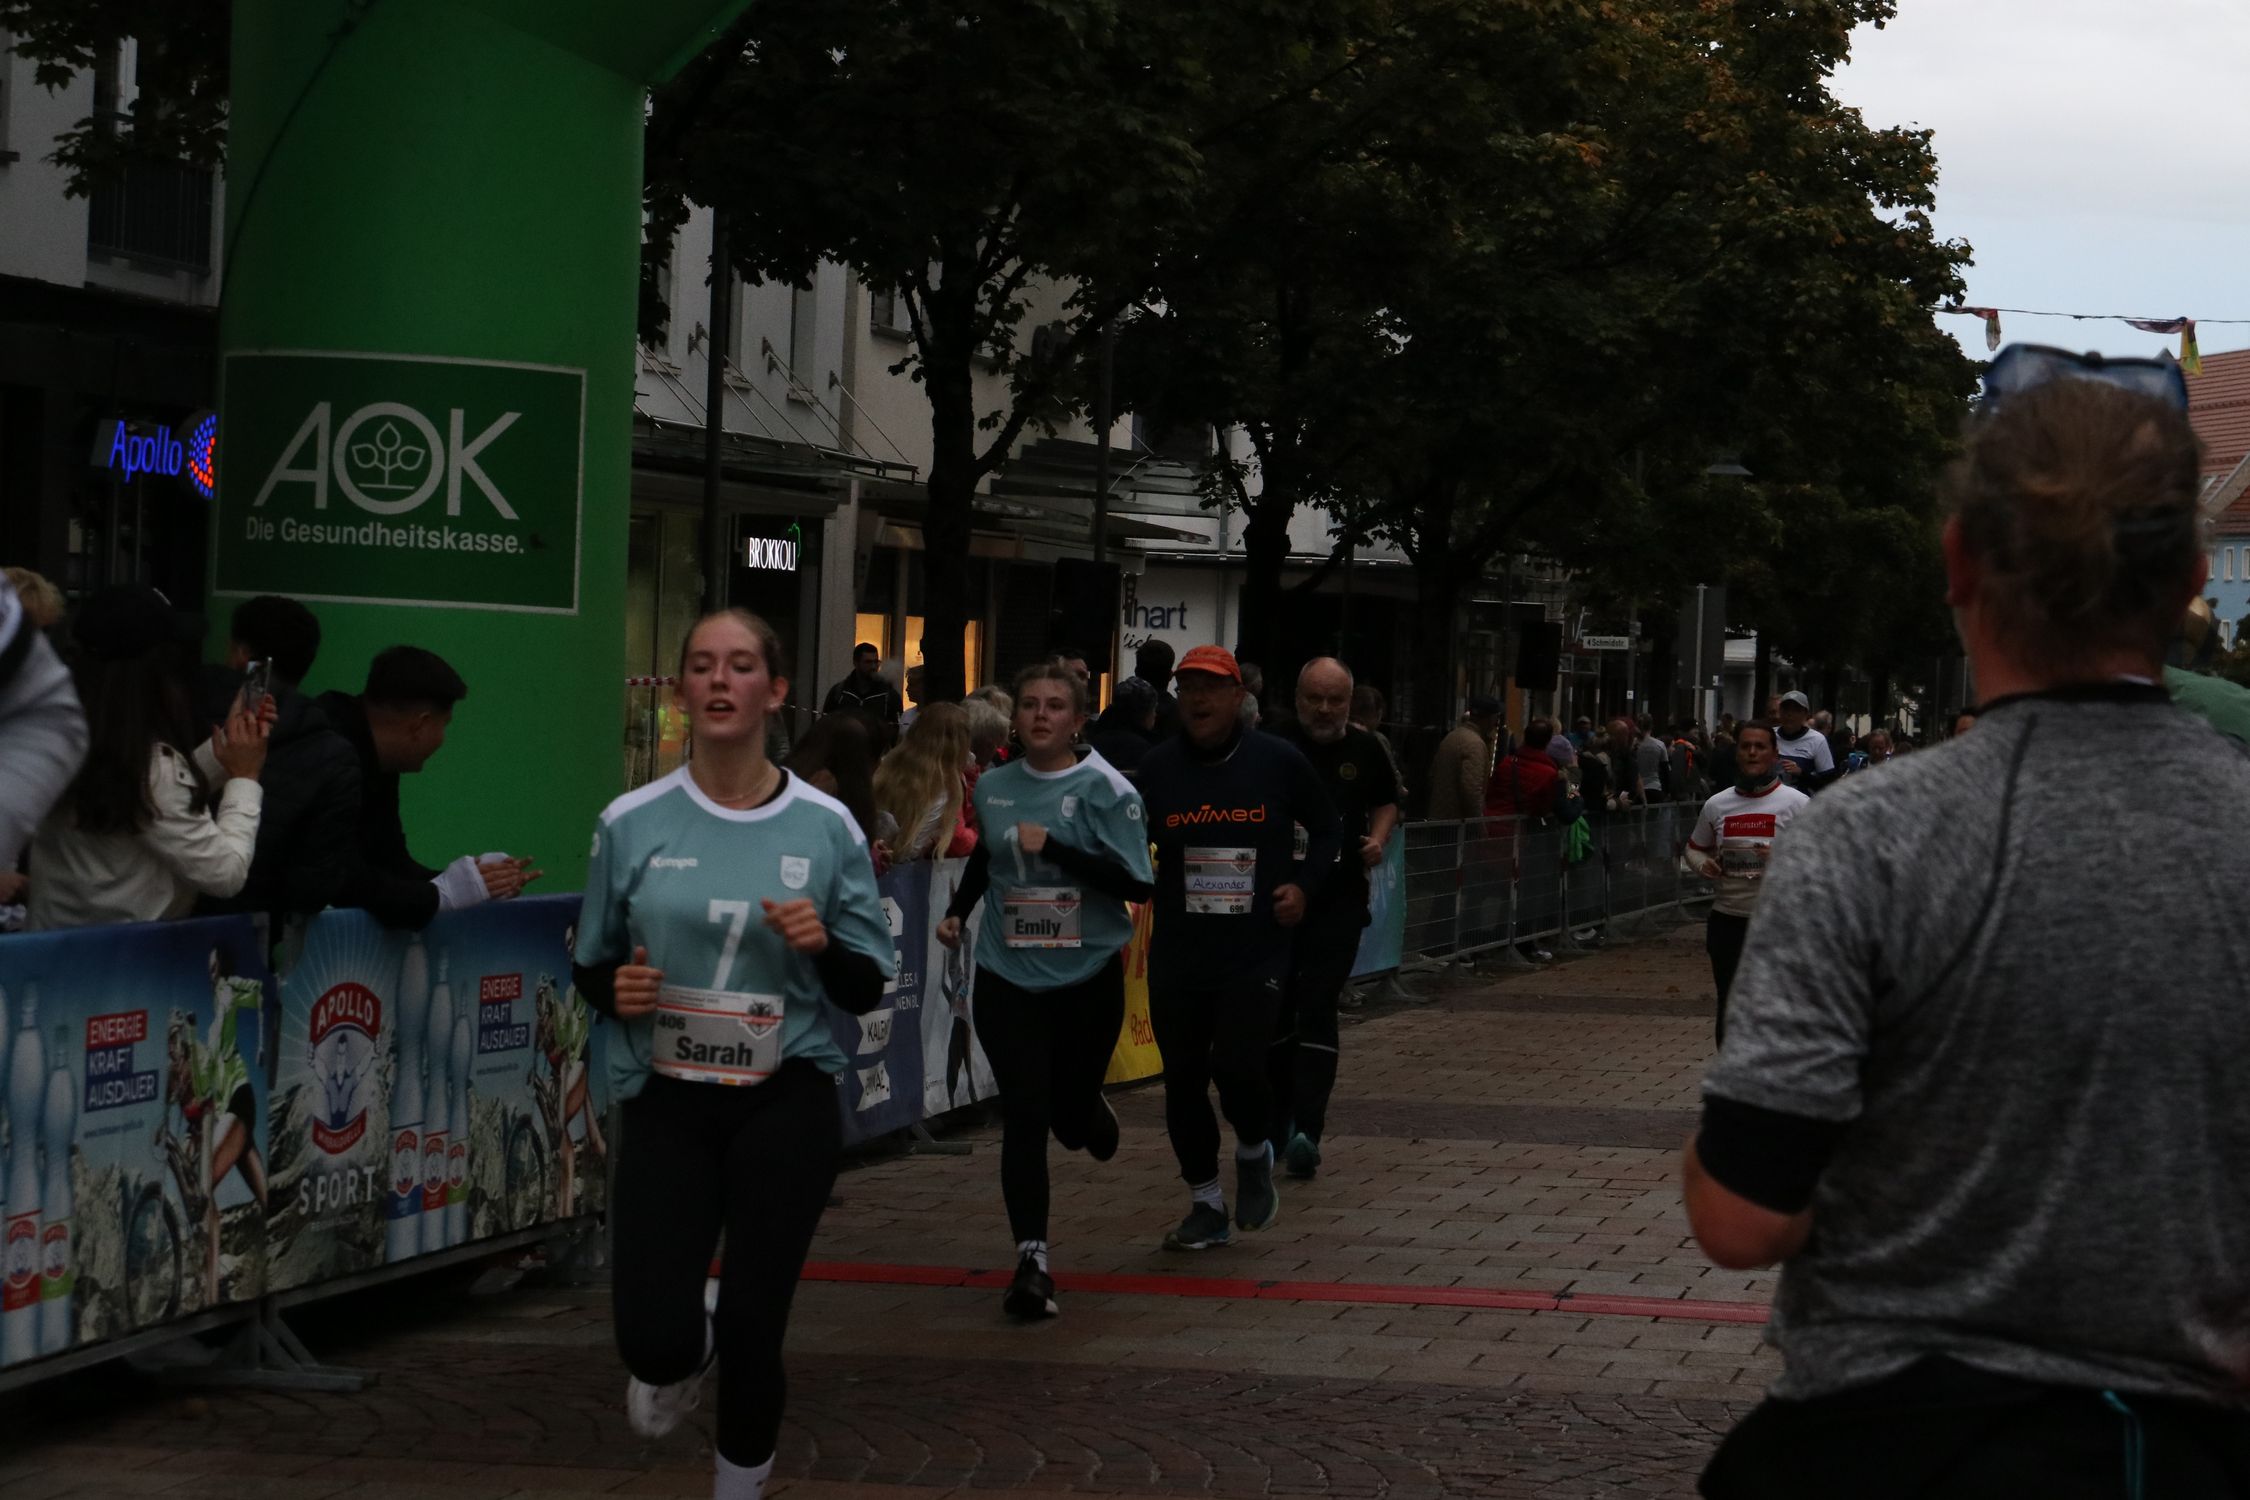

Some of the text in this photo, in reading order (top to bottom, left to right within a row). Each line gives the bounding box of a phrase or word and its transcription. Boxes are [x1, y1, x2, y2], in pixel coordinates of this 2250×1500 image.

[108, 419, 183, 484] Apollo
[253, 401, 523, 520] AOK
[246, 516, 525, 554] Die Gesundheitskasse.
[749, 537, 796, 571] BROKKOLI
[1165, 803, 1266, 828] ewimed
[650, 857, 699, 870] Kempa
[1229, 904, 1245, 913] 699
[1014, 919, 1061, 938] Emily
[708, 899, 750, 991] 7
[481, 977, 520, 1000] ENERGIE
[316, 990, 374, 1034] APOLLO
[481, 1003, 511, 1025] KRAFT
[658, 1014, 686, 1031] 406
[89, 1014, 144, 1044] ENERGIE
[480, 1026, 528, 1050] AUSDAUER
[88, 1047, 132, 1075] KRAFT
[675, 1036, 753, 1067] Sarah
[88, 1075, 156, 1107] AUSDAUER
[298, 1165, 377, 1215] SPORT
